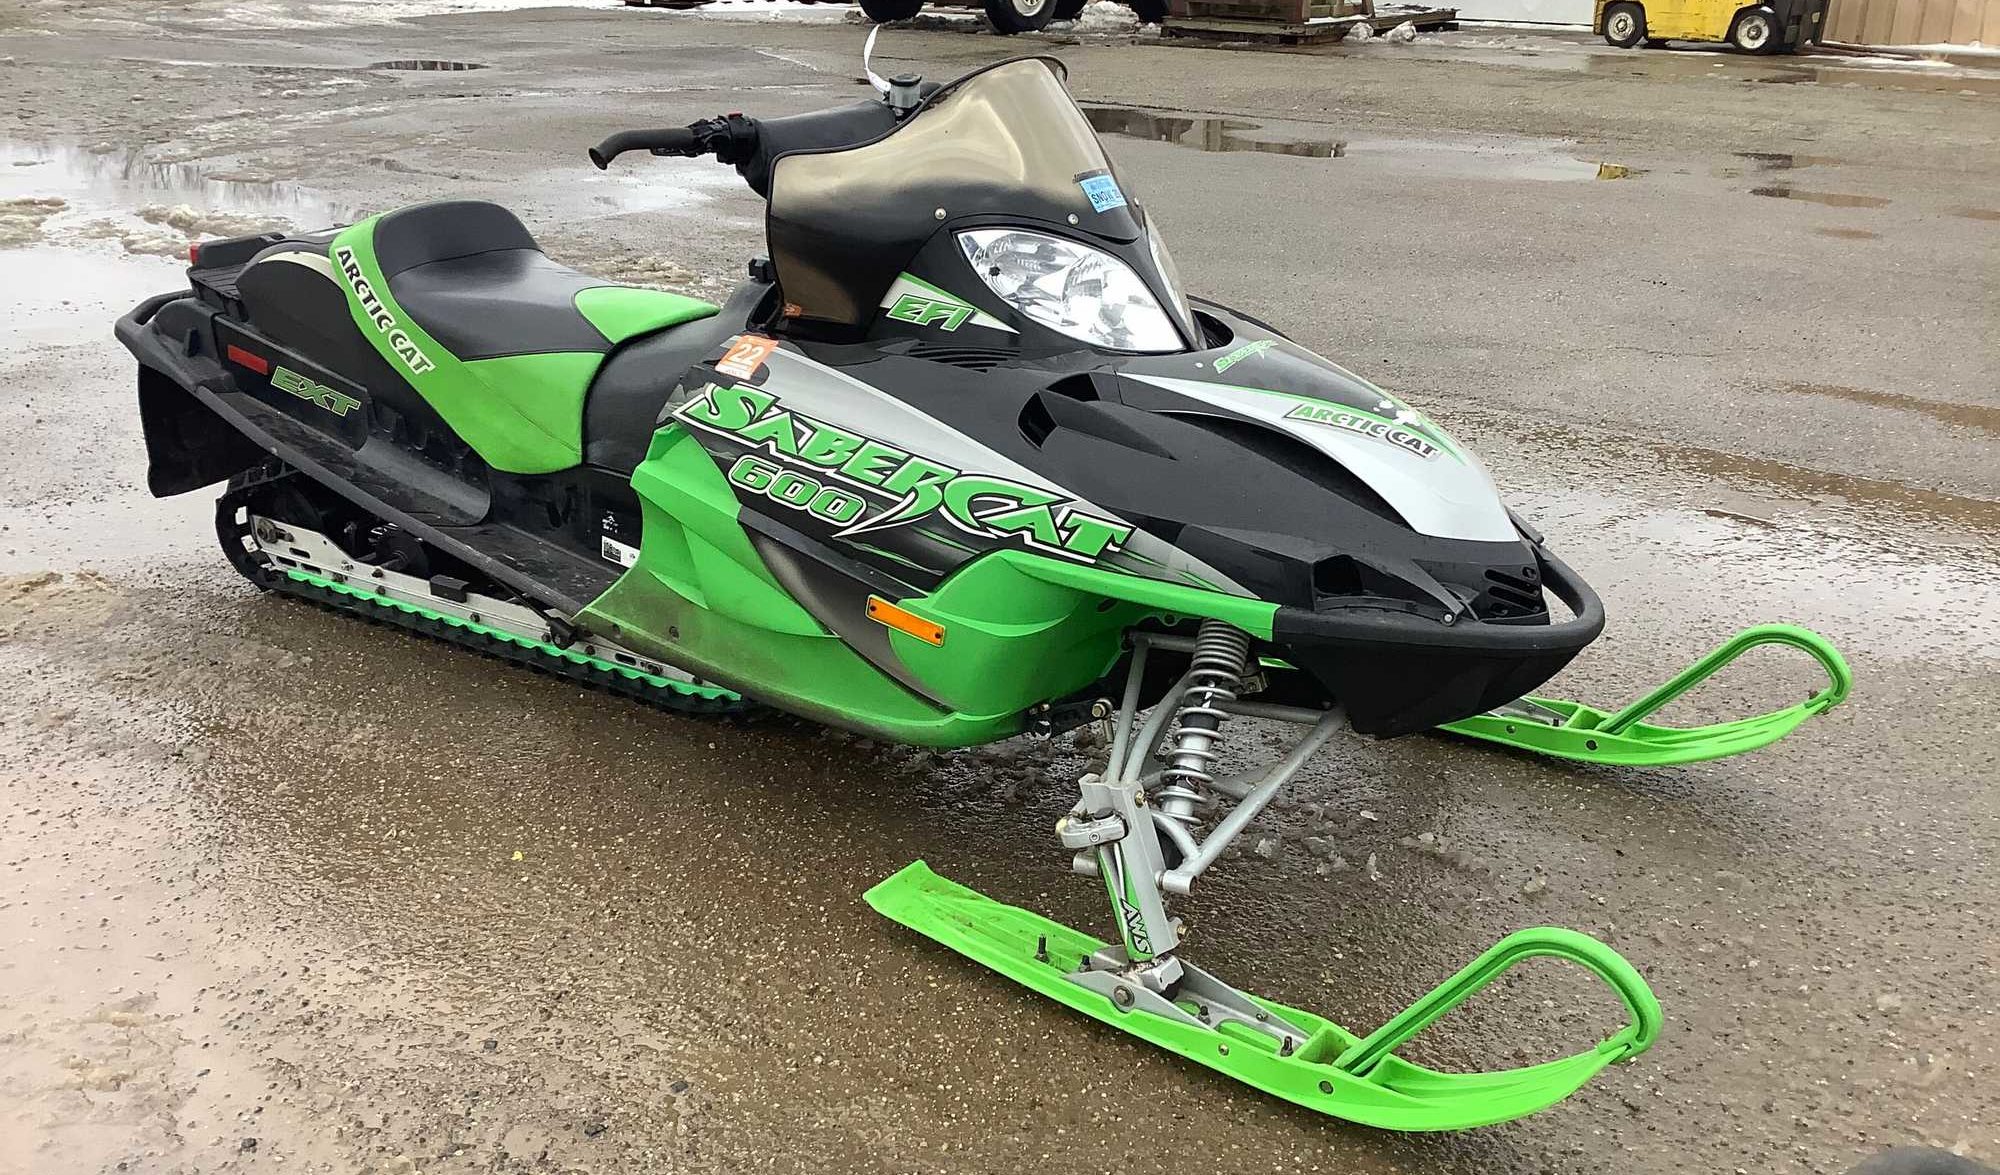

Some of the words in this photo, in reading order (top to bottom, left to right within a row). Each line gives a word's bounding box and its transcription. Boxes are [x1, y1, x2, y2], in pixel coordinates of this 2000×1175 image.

[337, 249, 393, 330] ARCTIC
[390, 333, 431, 371] CAT
[886, 294, 976, 332] EFI
[727, 343, 764, 365] 22
[270, 365, 361, 417] EXT
[1293, 404, 1388, 436] ARCTIC
[1391, 429, 1439, 456] CAT
[728, 454, 867, 527] 600
[1120, 898, 1154, 954] AWS
